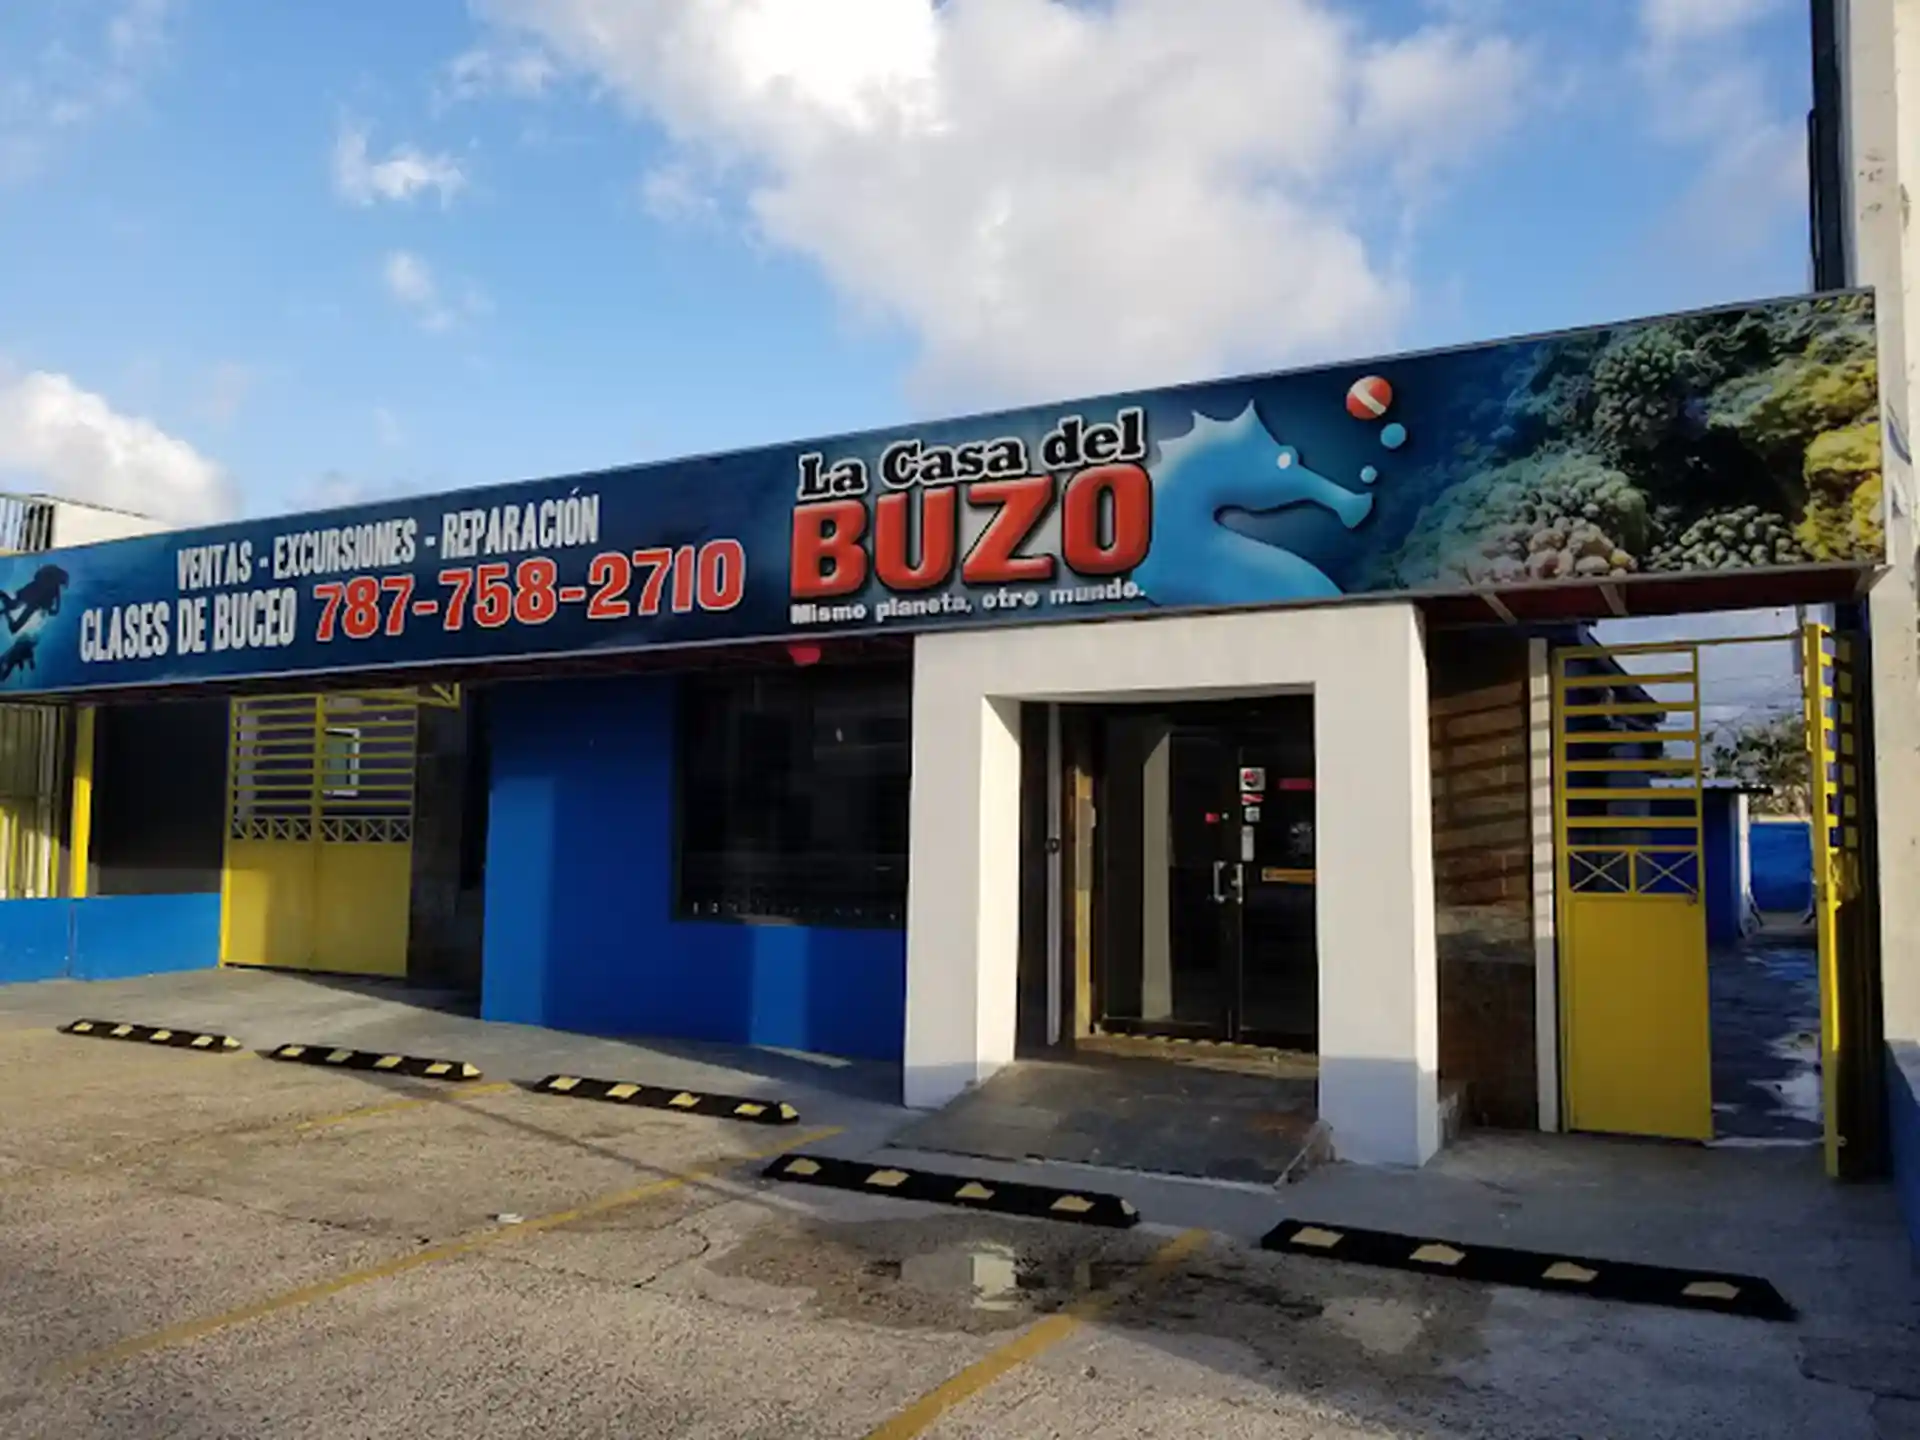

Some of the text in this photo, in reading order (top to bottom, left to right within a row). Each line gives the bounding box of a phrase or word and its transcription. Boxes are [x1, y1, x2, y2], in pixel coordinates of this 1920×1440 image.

[799, 407, 1145, 500] La Casa del
[177, 540, 253, 591] VENTAS
[274, 519, 417, 580] EXCURSIONES
[440, 487, 600, 559] REPARACIÓN
[790, 462, 1152, 600] BUZO
[80, 539, 746, 662] CLASES DE BUCEO 787-758-2710
[791, 578, 1147, 624] Mismo planeta, otro mundo.
